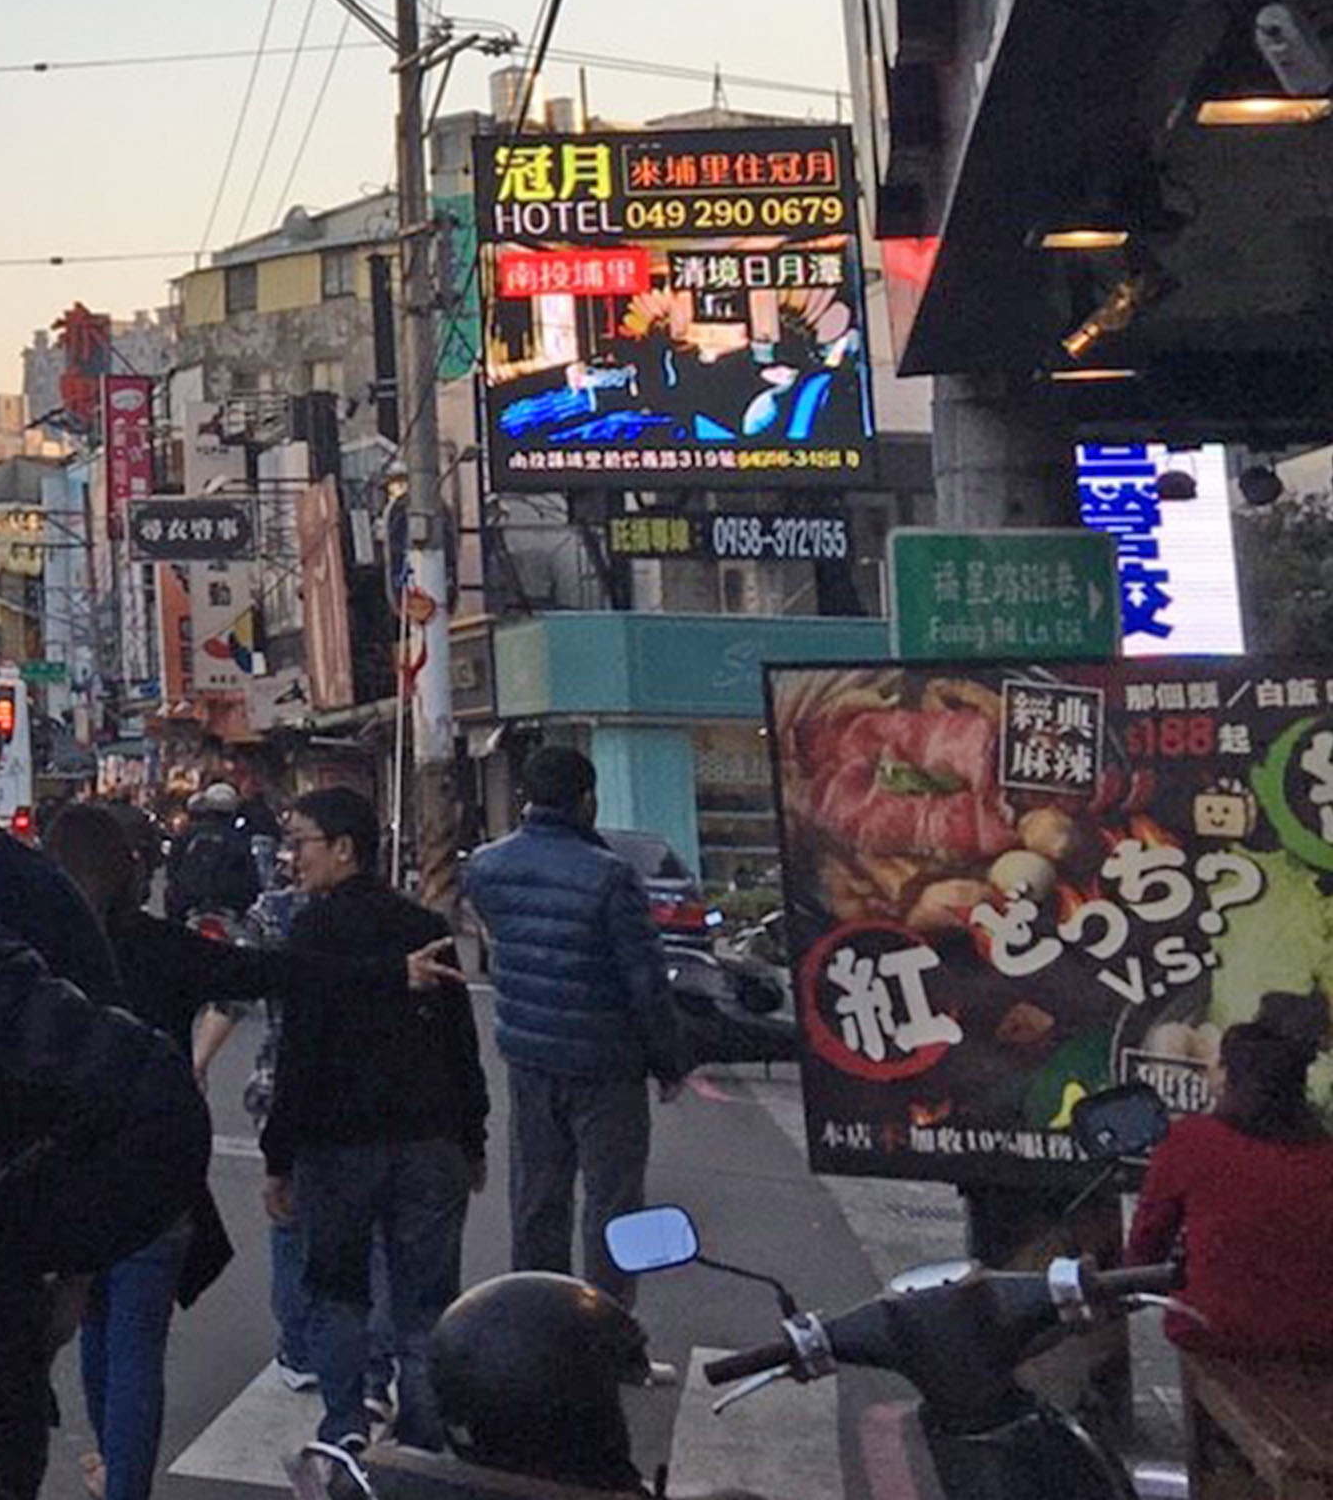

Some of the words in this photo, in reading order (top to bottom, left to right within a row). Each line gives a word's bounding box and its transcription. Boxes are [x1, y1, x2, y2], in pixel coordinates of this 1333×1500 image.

[494, 143, 612, 201] 冠月
[630, 150, 835, 187] 來埔里住冠月
[494, 200, 623, 235] HOTEL
[626, 201, 686, 229] 049
[693, 199, 754, 228] 290
[761, 196, 844, 226] 0679
[506, 257, 638, 293] 南投埔里
[673, 253, 845, 289] 清境日月潭
[712, 516, 848, 559] 0958-372755
[1010, 691, 1095, 738] 經典
[826, 944, 964, 1062] 紅
